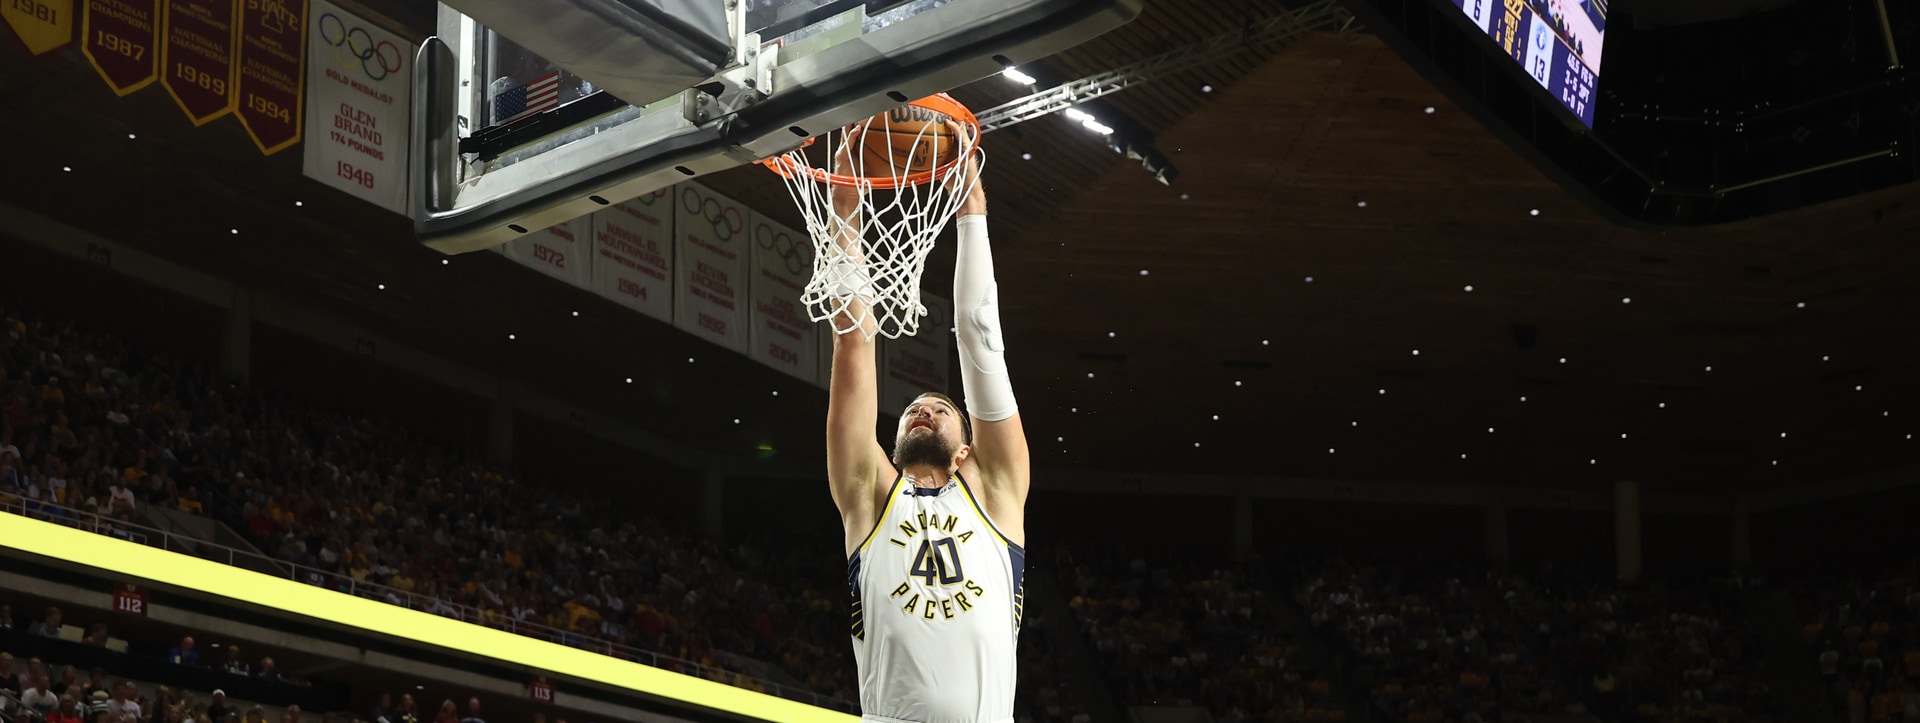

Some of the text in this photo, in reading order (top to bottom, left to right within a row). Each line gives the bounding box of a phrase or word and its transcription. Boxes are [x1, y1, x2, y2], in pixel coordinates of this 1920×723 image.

[97, 30, 146, 61] 1987
[177, 62, 226, 96] 1989
[1534, 54, 1546, 82] 13
[1564, 69, 1578, 92] 3-5
[325, 68, 393, 105] GOLD MEDALIST
[248, 93, 291, 124] 1994
[340, 103, 376, 129] GLEN
[1562, 87, 1585, 118] 0-0 FT
[334, 115, 382, 146] BRAND
[330, 131, 384, 161] 174 POUNDS
[337, 161, 374, 189] 1948
[533, 243, 565, 269] 1972
[618, 277, 647, 301] 1984
[889, 509, 974, 547] INDANA
[910, 537, 964, 586] 40
[119, 596, 142, 613] 112
[890, 579, 984, 620] PACERS
[534, 686, 550, 700] 113
